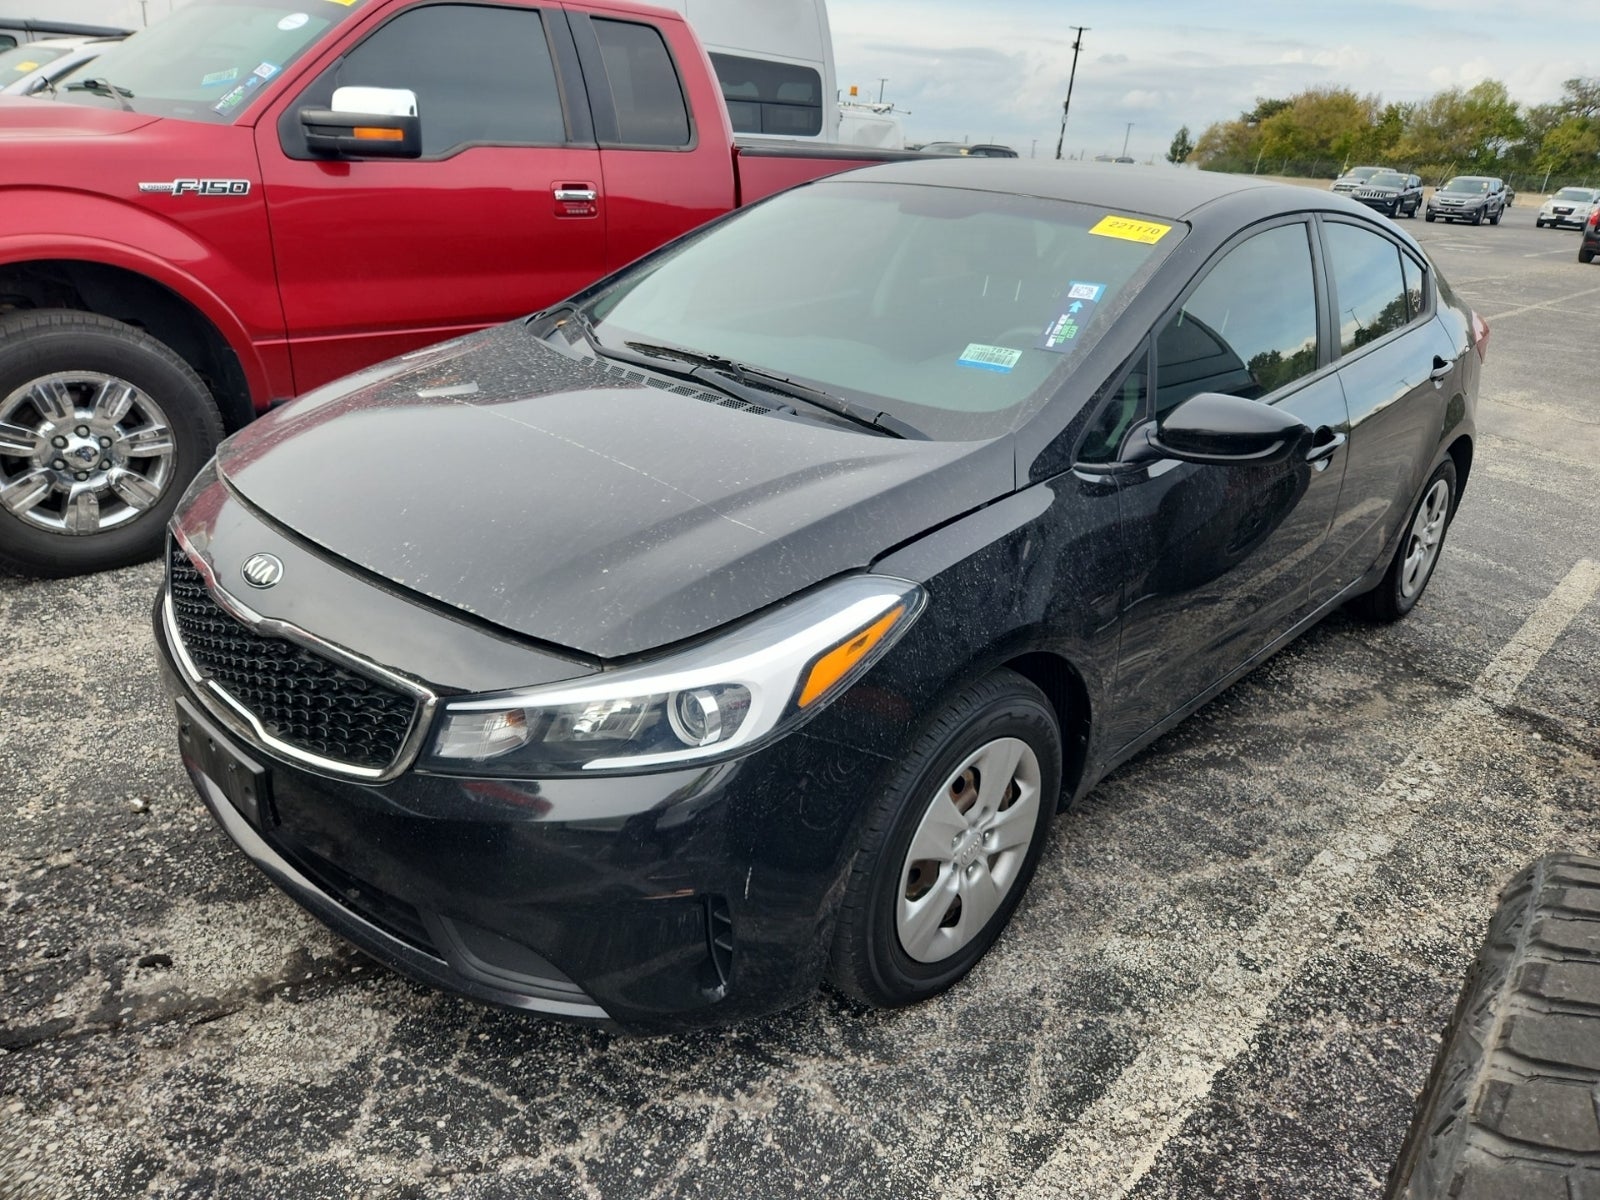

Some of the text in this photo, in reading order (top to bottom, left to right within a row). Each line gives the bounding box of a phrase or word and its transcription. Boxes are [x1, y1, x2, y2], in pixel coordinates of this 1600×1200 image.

[173, 179, 250, 195] F-150
[1108, 220, 1161, 235] 221170
[244, 556, 276, 584] KIA
